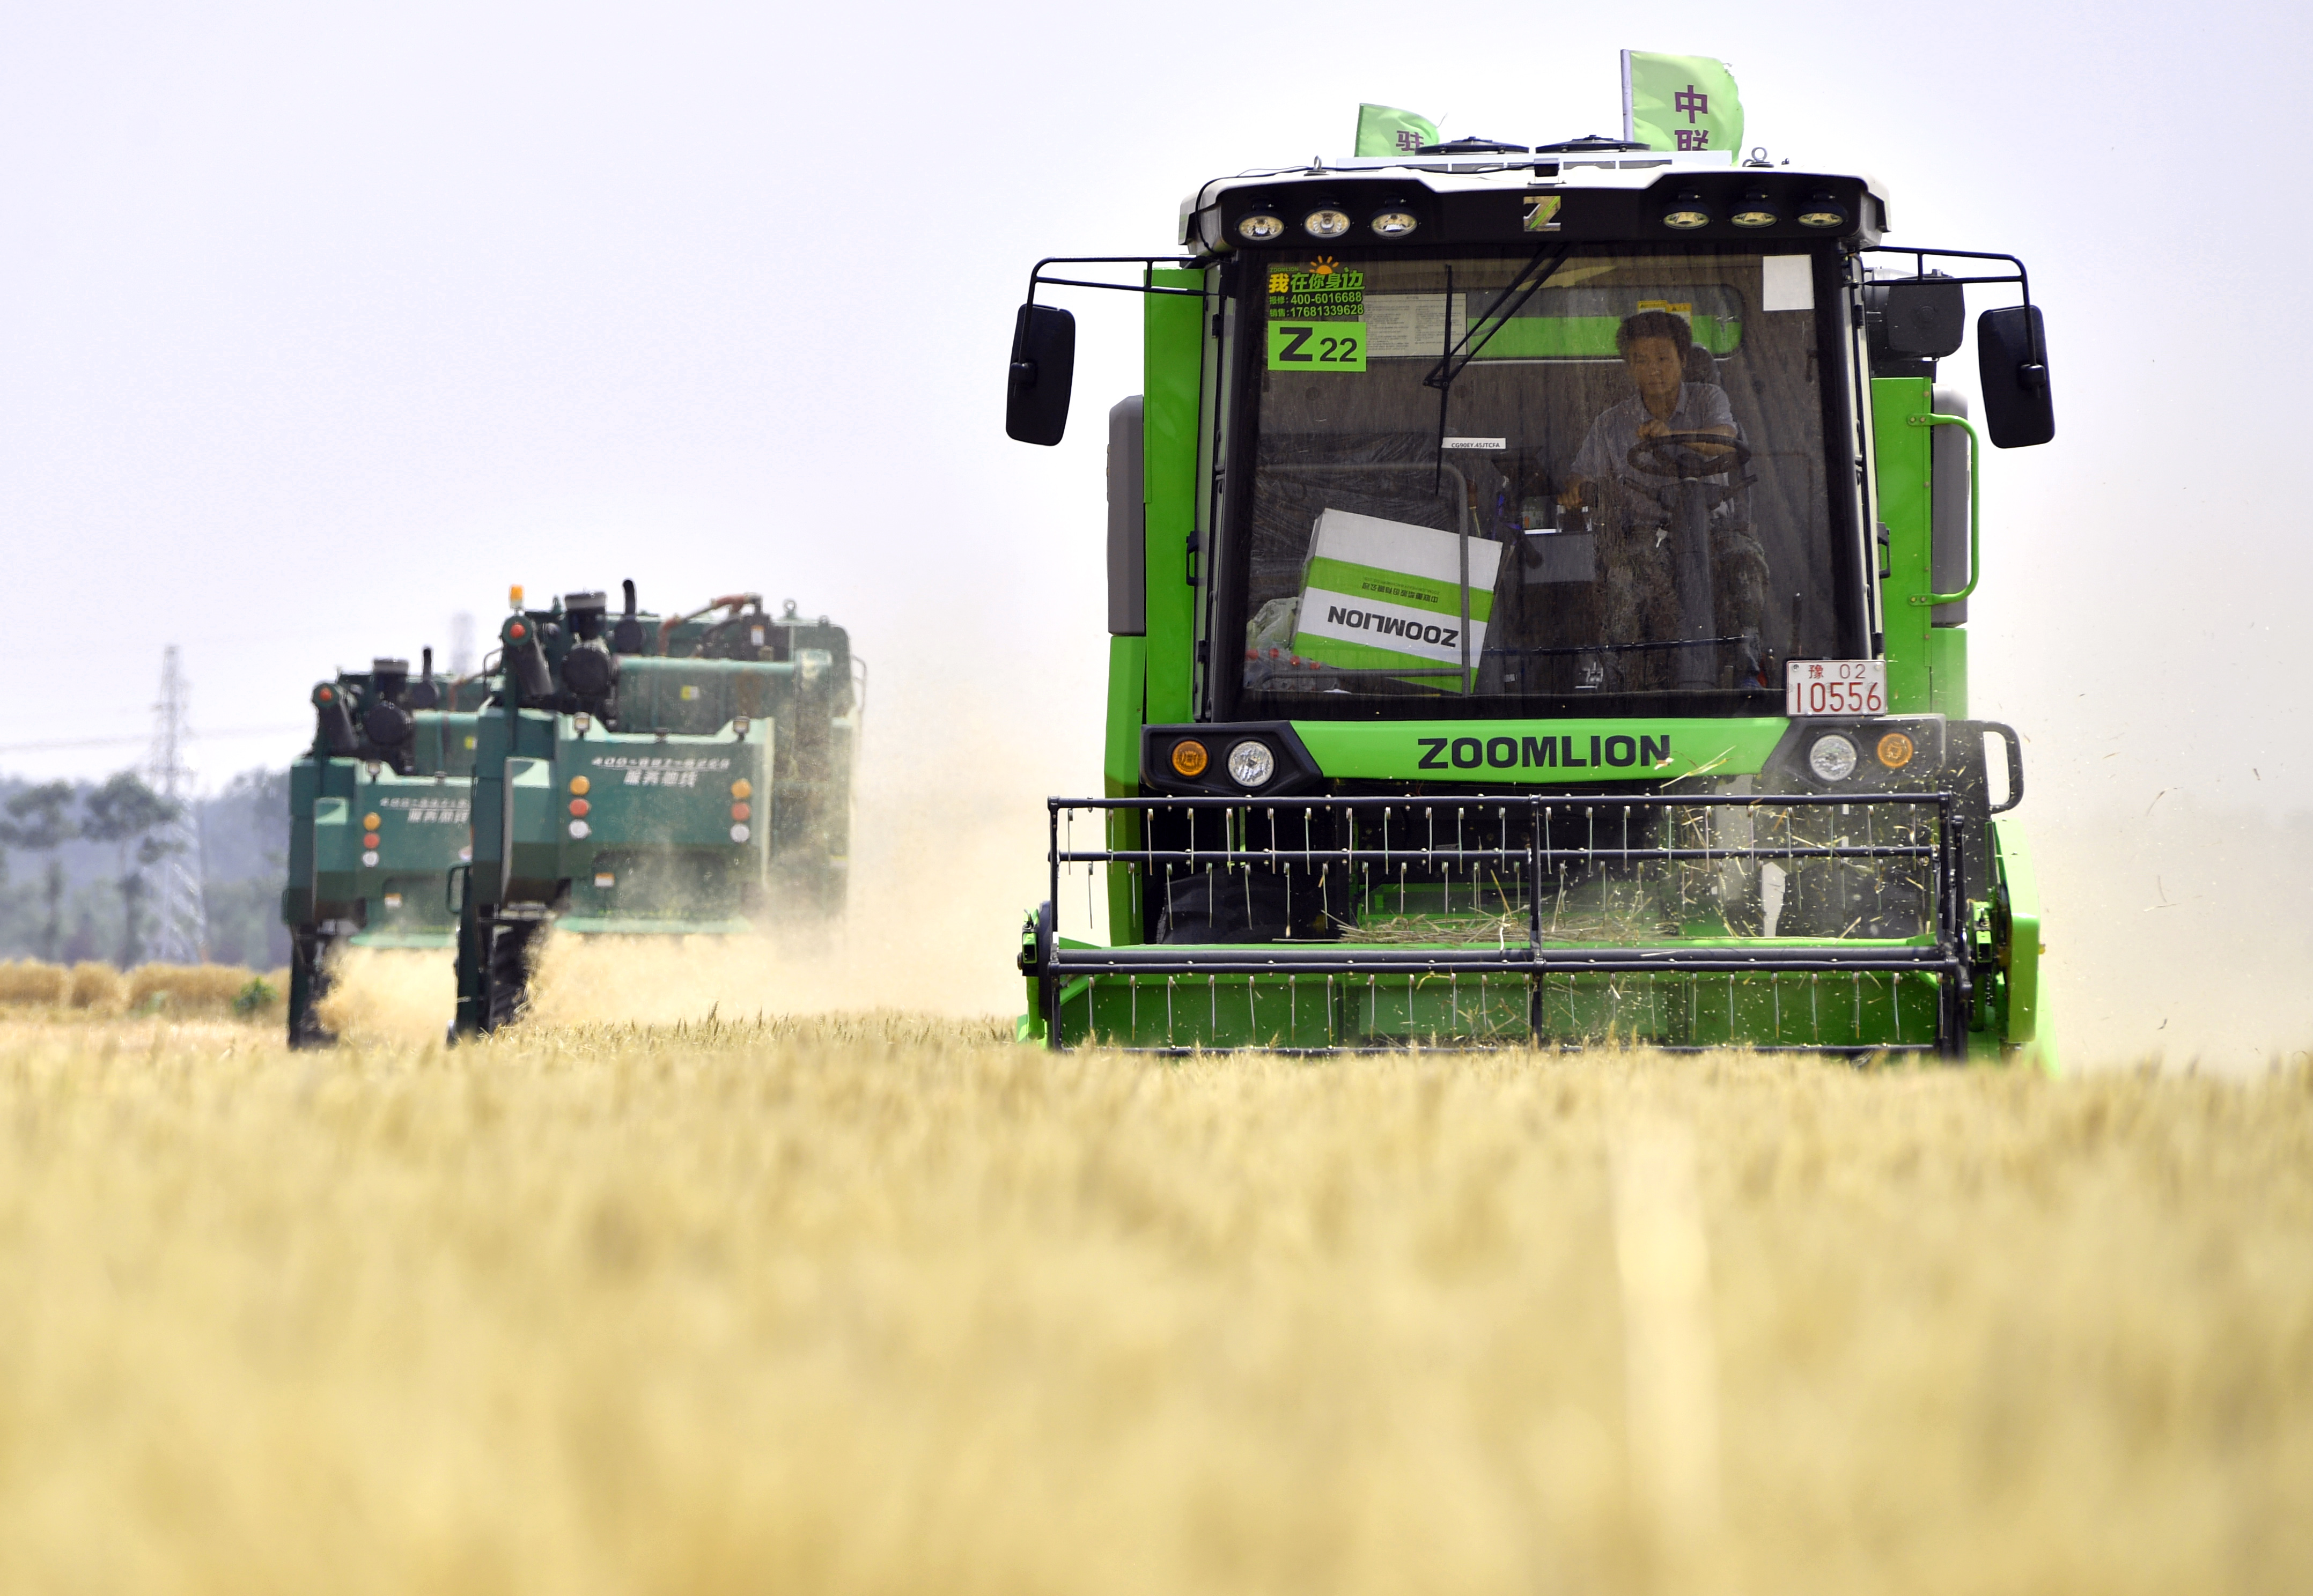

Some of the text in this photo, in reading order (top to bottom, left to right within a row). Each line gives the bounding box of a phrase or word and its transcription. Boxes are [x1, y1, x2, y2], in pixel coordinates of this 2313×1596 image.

[1269, 267, 1365, 293] 我在你身边
[1291, 291, 1362, 305] 400-6016688
[1291, 304, 1364, 317] 17681339628
[1327, 605, 1459, 648] ZOOMLION
[1808, 664, 1824, 679] 豫
[1797, 682, 1882, 713] 10556
[1418, 735, 1671, 769] ZOOMLION
